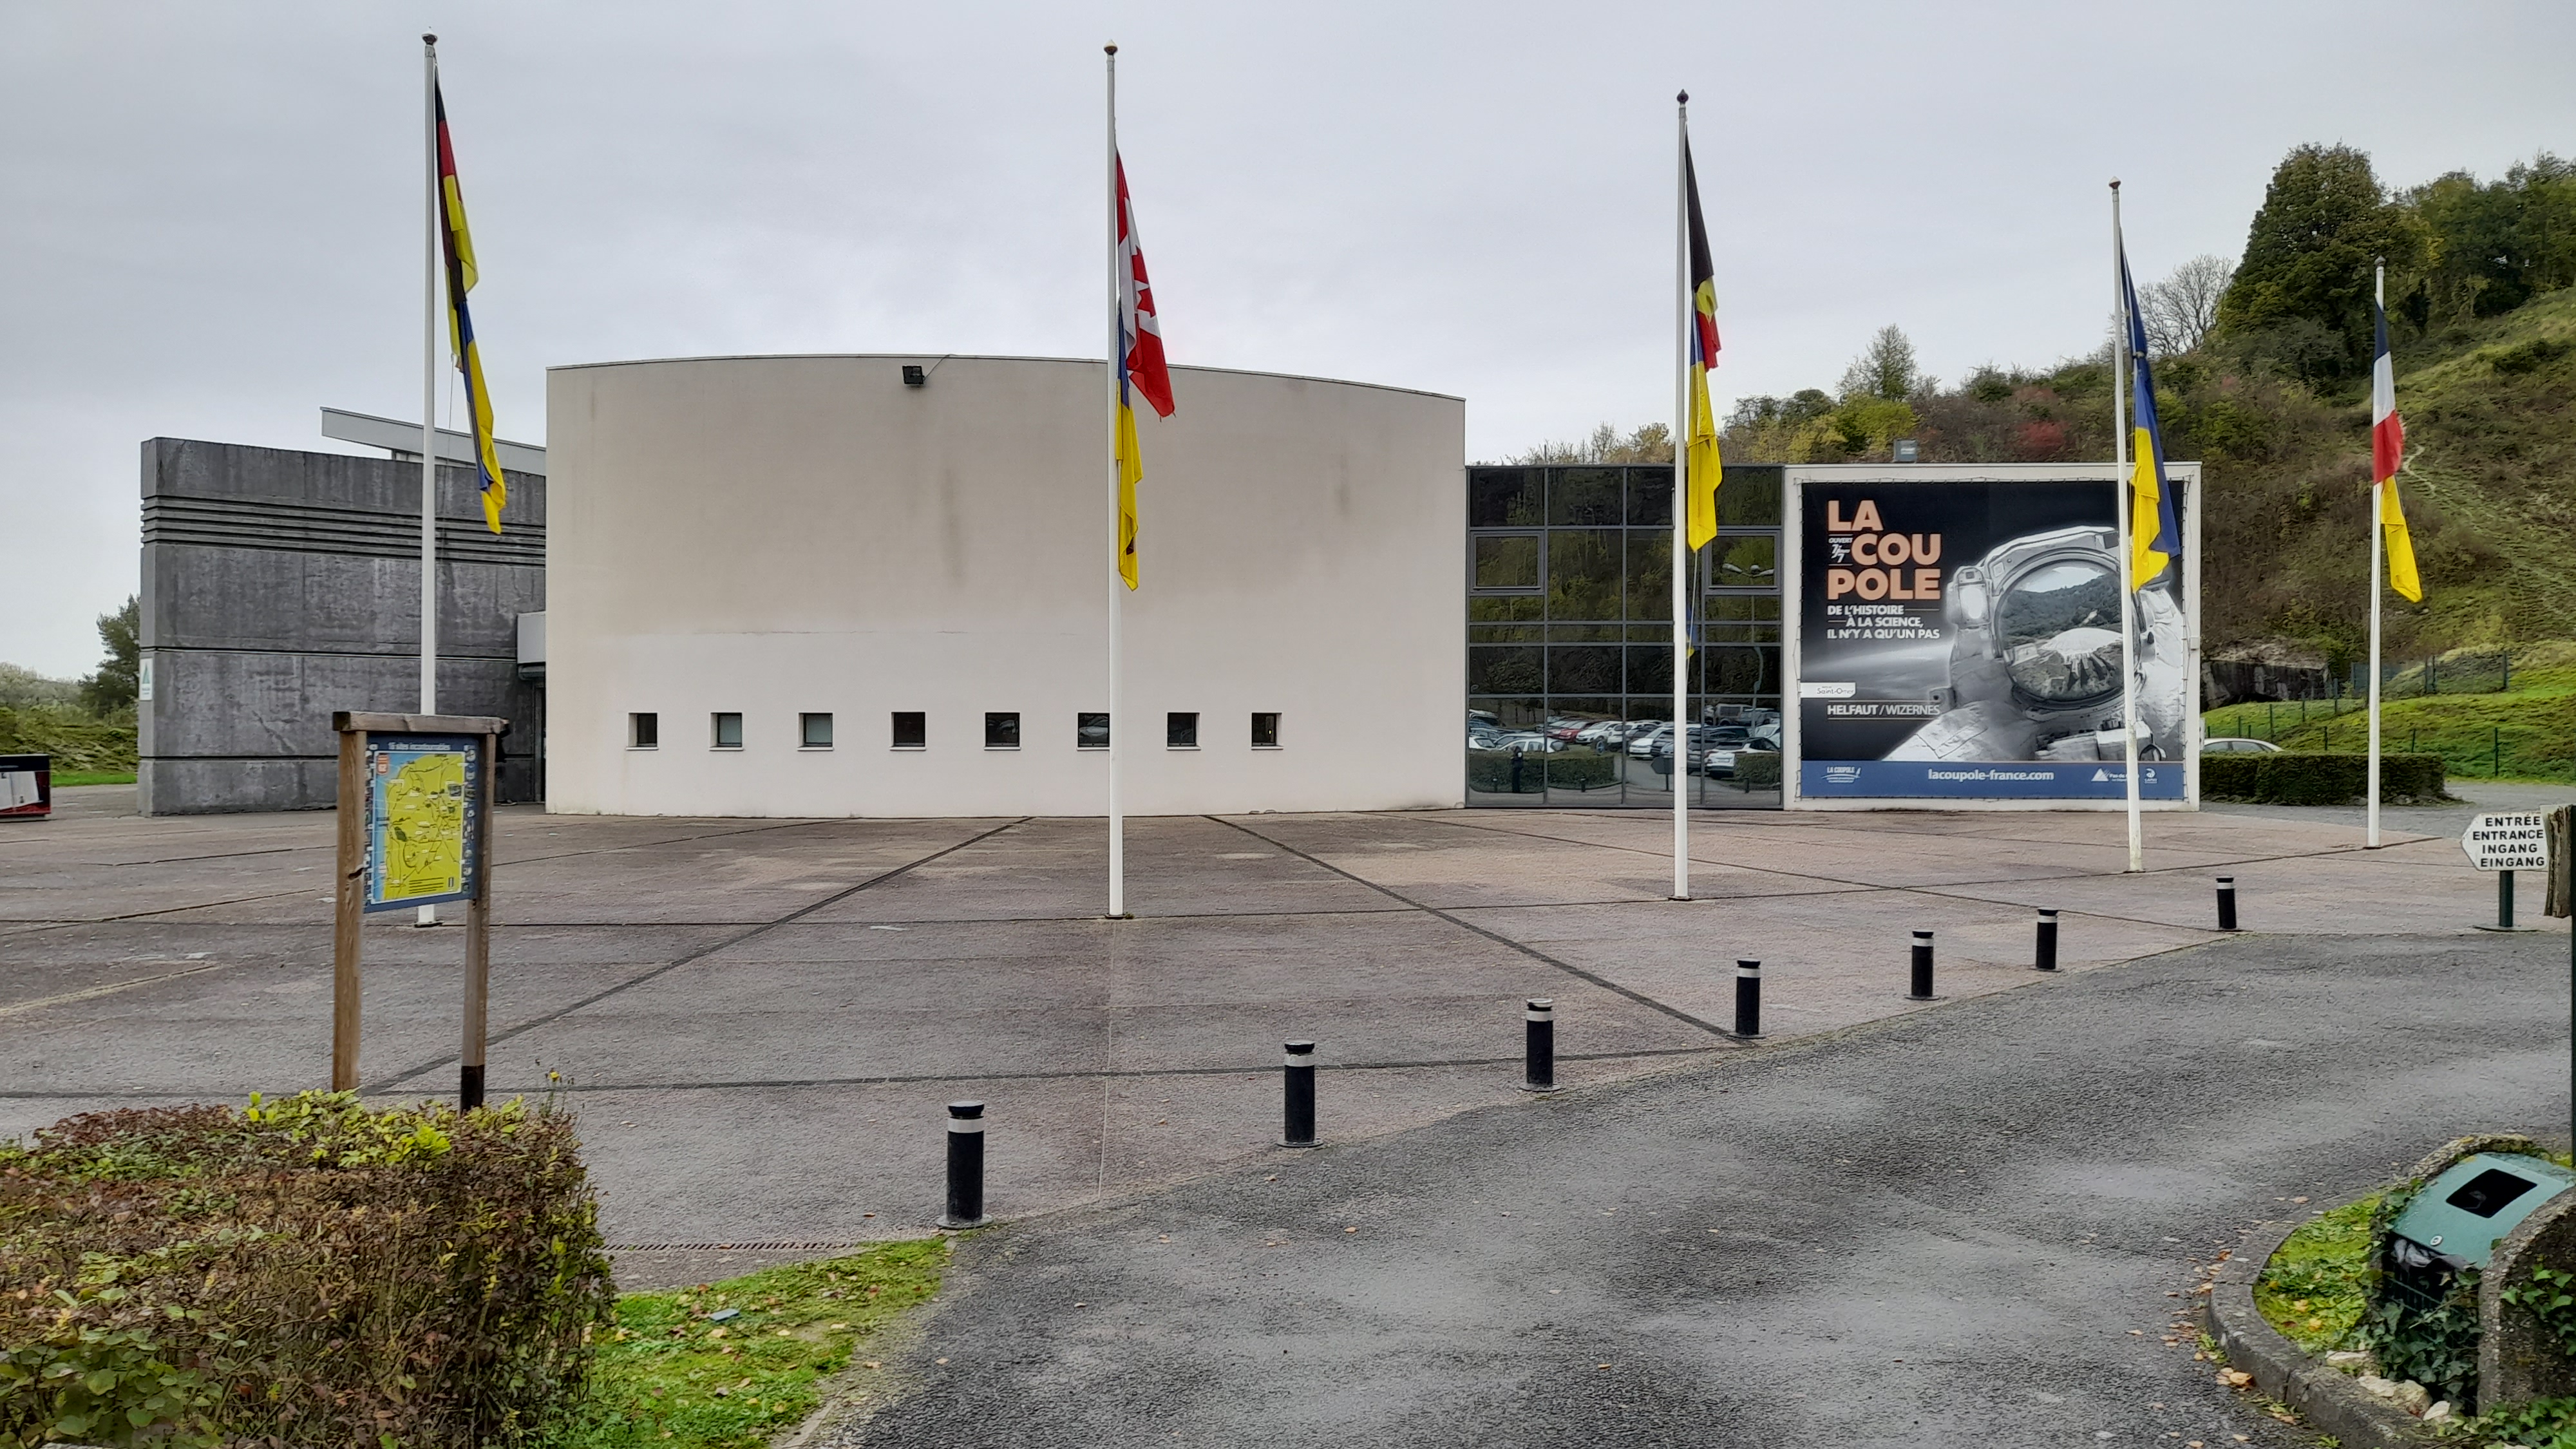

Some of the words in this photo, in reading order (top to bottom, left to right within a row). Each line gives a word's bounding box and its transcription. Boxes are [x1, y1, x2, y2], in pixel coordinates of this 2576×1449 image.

[1828, 500, 1884, 531] LA
[1851, 533, 1942, 565] COU
[1827, 567, 1941, 601] POLE
[1827, 605, 1842, 616] DE
[1844, 605, 1904, 616] L'HISTOIRE
[1846, 614, 1856, 627] À
[1857, 616, 1873, 627] LA
[1875, 616, 1924, 629] SCIENCE,
[1827, 629, 1837, 639] IL
[1839, 629, 1861, 639] N'Y
[1862, 629, 1873, 639] A
[1874, 629, 1915, 639] QU'UN
[1918, 629, 1940, 639] PAS
[1927, 768, 2054, 782] lacoupole-france.com
[2473, 829, 2544, 840] ENTRANCE
[2482, 844, 2537, 854] INGANG
[2480, 857, 2544, 867] EINGANG
